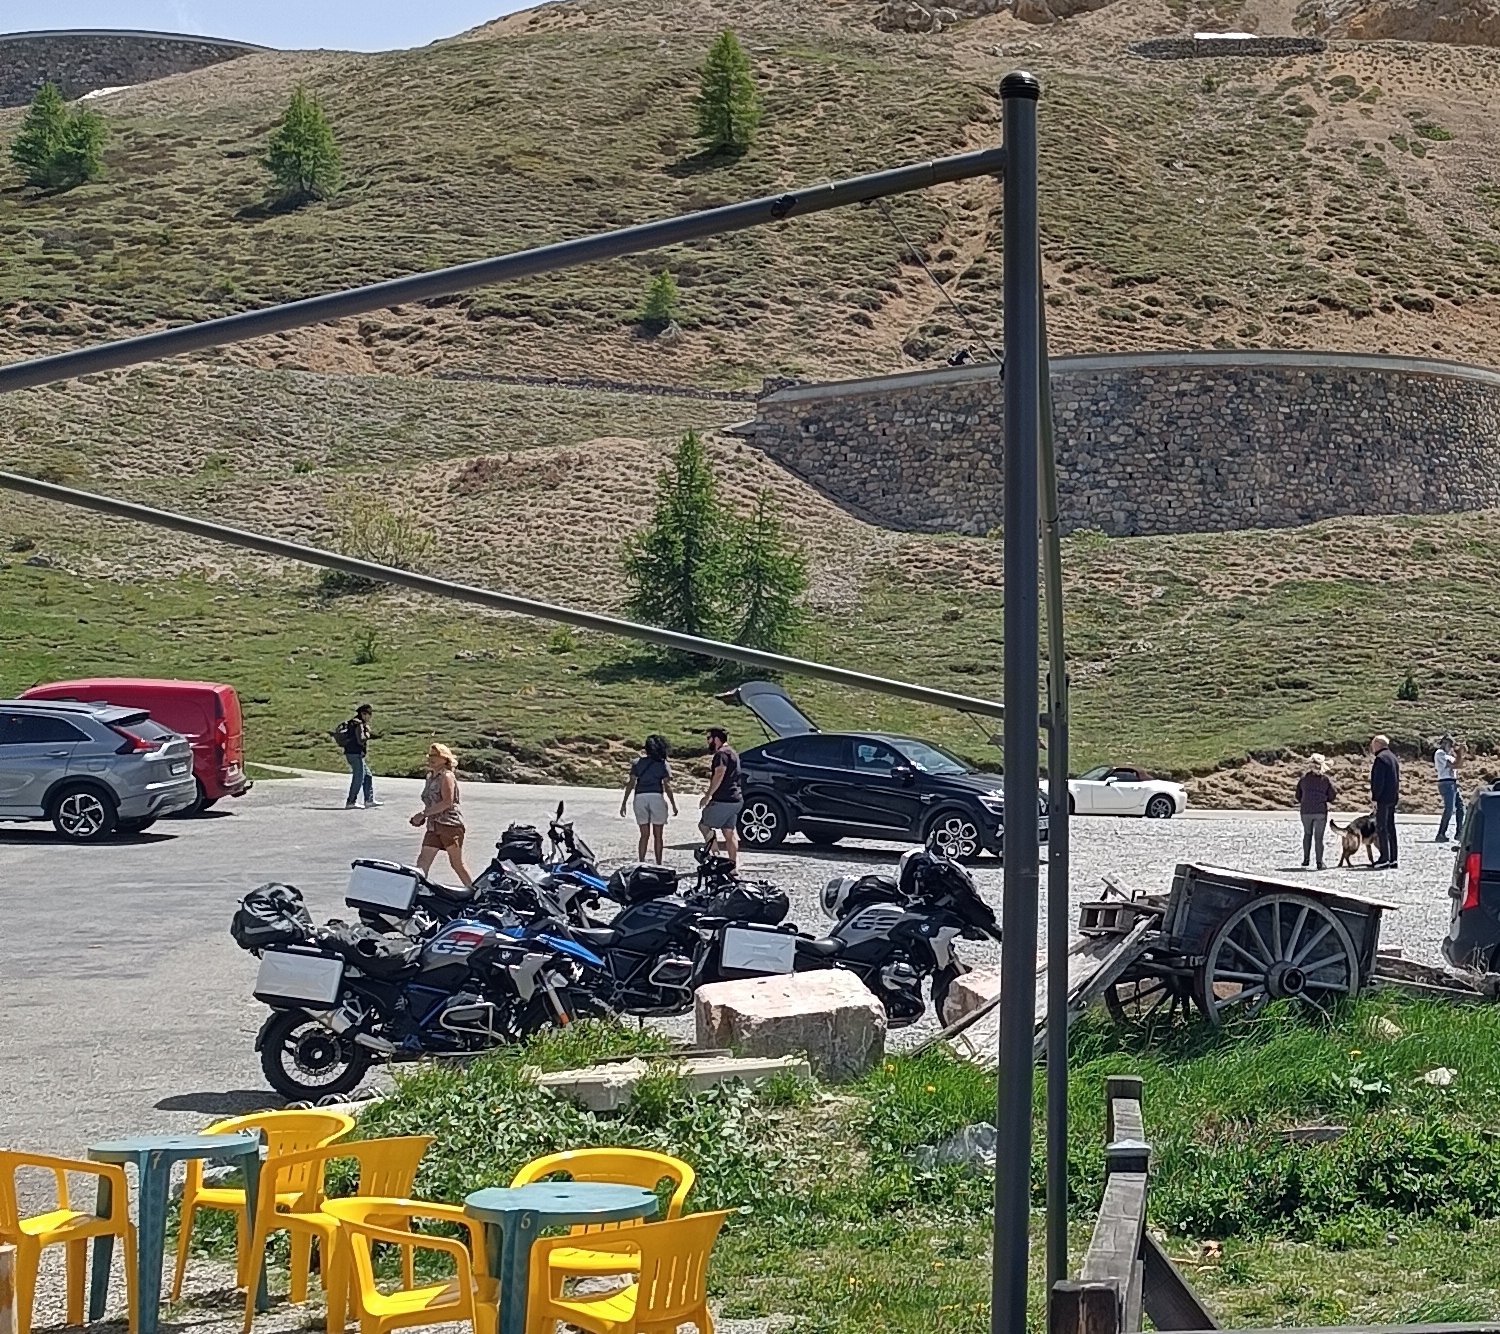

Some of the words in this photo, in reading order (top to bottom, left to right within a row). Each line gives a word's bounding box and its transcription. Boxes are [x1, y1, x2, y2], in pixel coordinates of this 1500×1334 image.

[637, 902, 680, 920] GS
[851, 916, 899, 931] GS
[431, 939, 477, 956] GS
[151, 1150, 164, 1170] 7
[520, 1211, 532, 1229] 6
